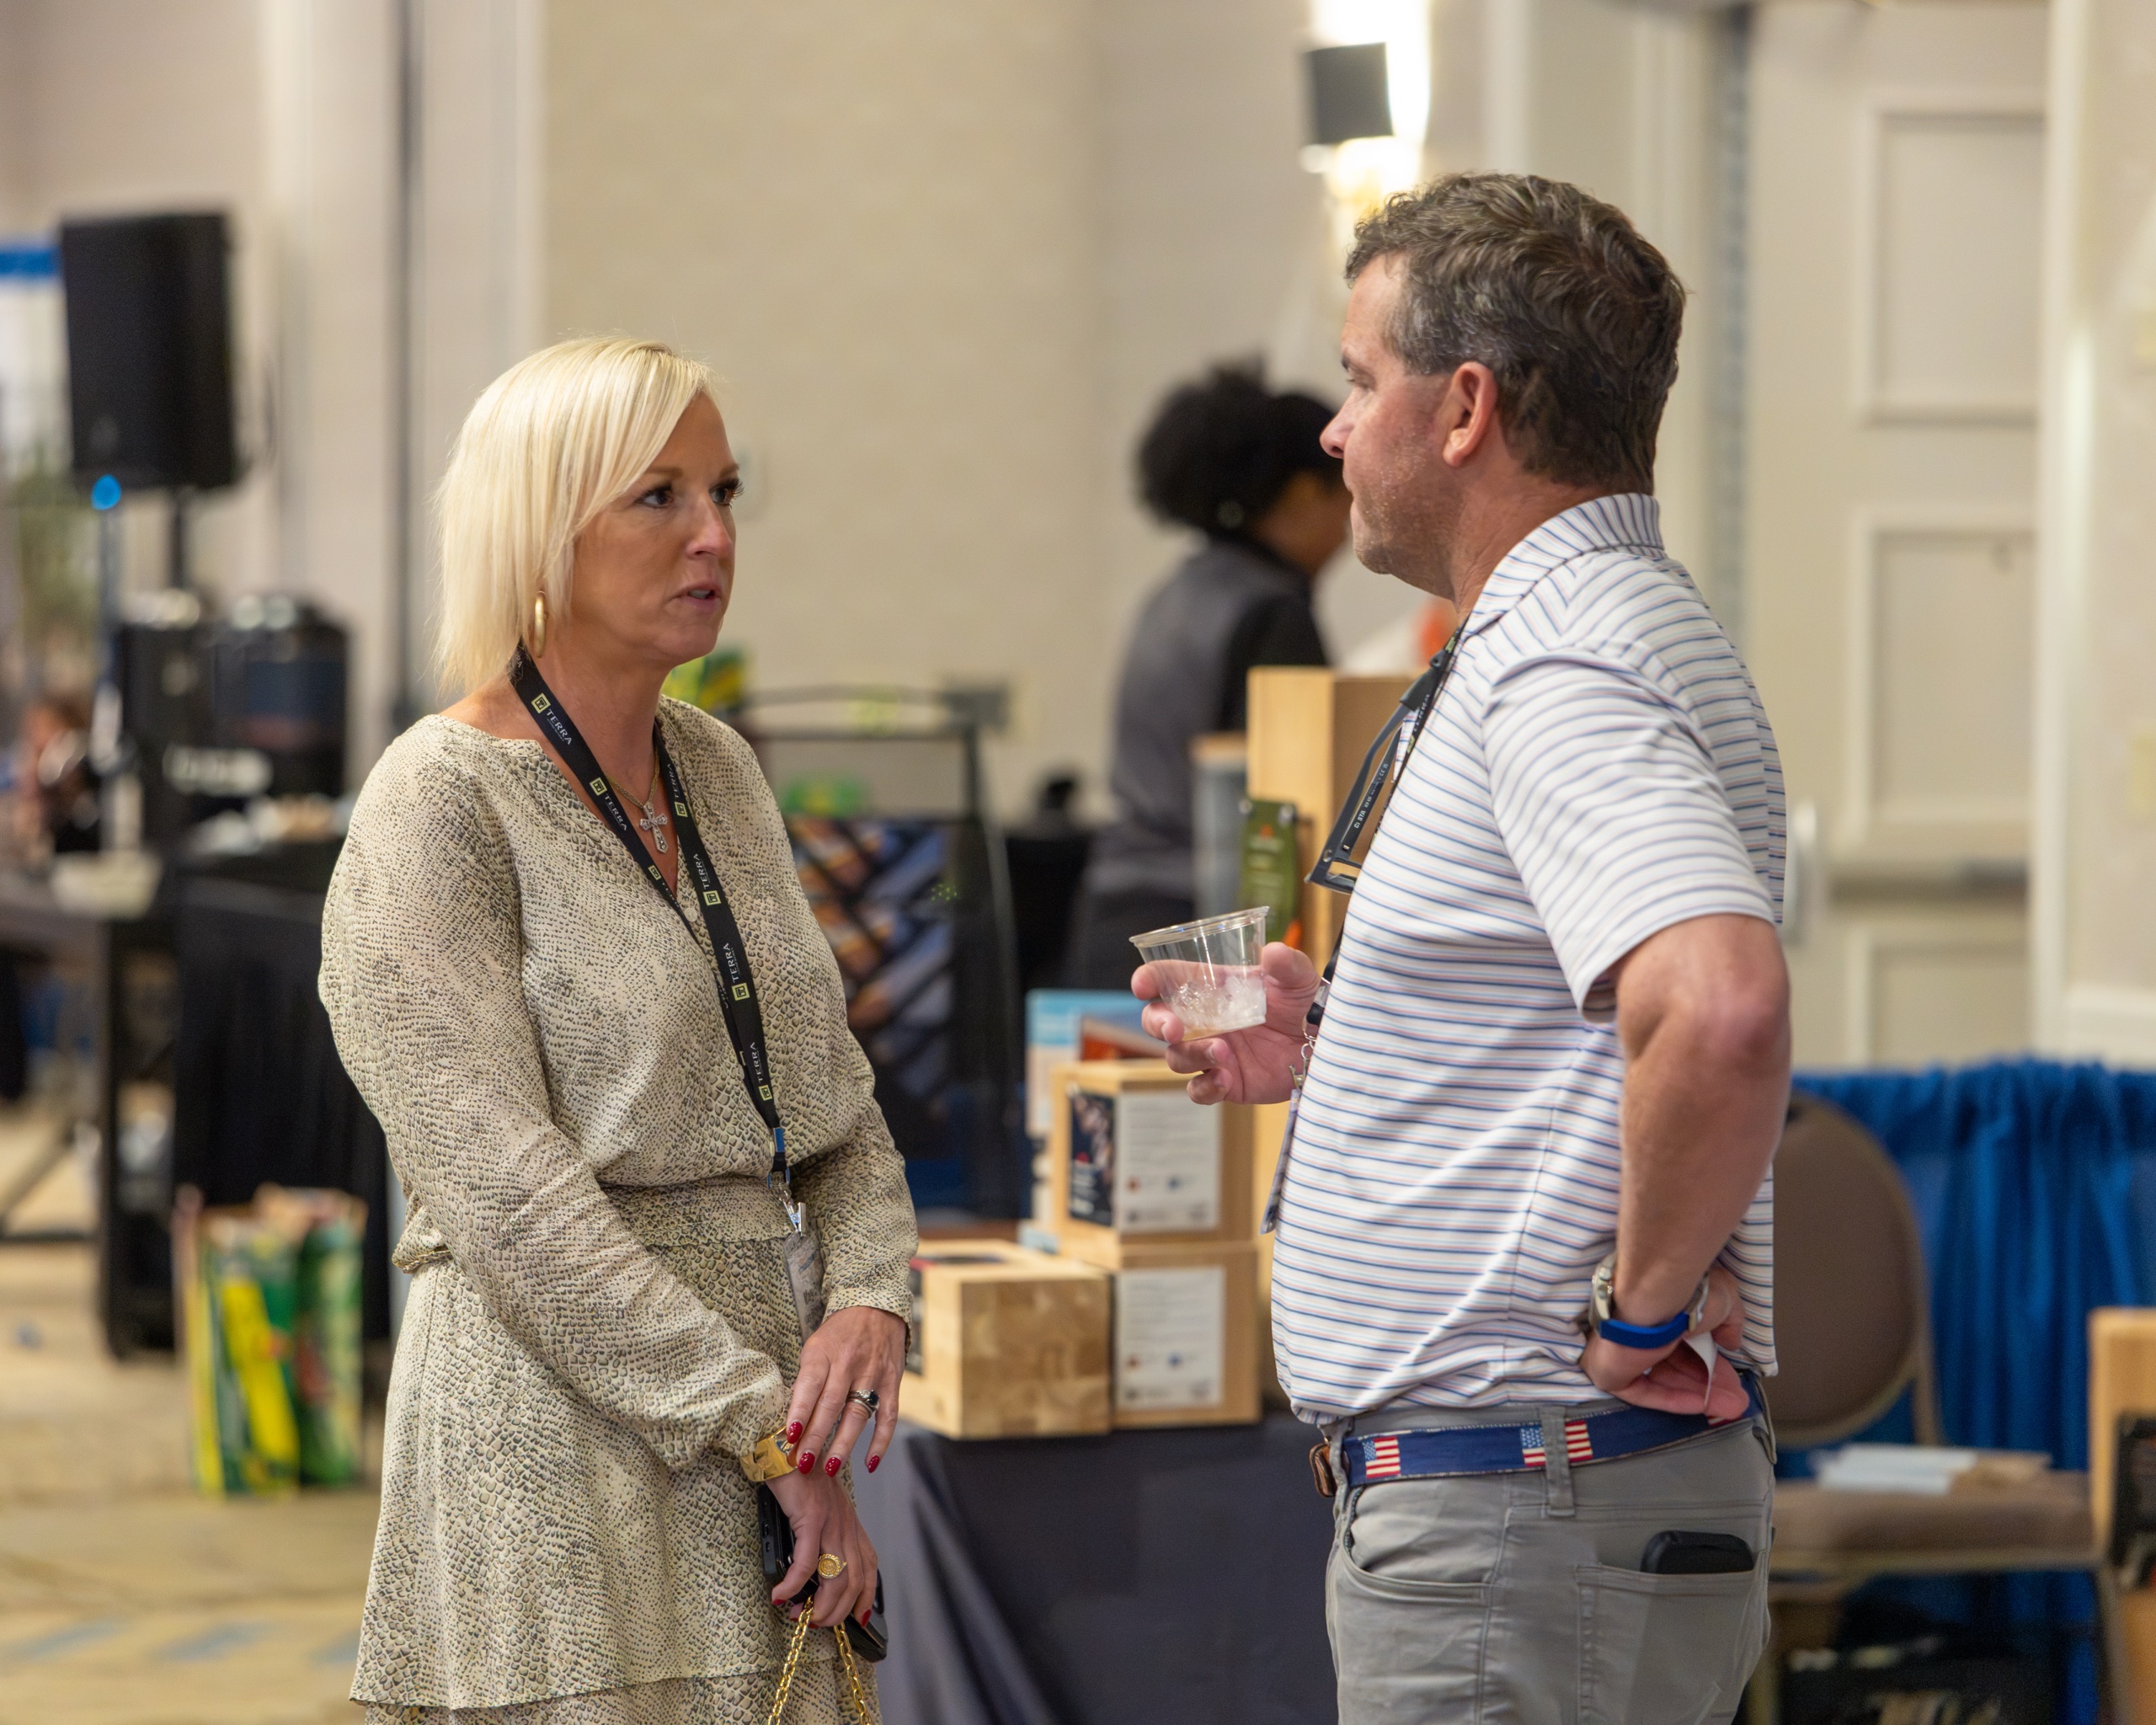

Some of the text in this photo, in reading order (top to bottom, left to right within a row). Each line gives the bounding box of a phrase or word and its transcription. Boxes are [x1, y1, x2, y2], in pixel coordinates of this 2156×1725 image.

[547, 708, 572, 745] TERRA
[605, 793, 627, 831] TERRA
[693, 853, 710, 889] TERRA
[723, 943, 739, 983] TERRA
[750, 1042, 763, 1083] TERRA
